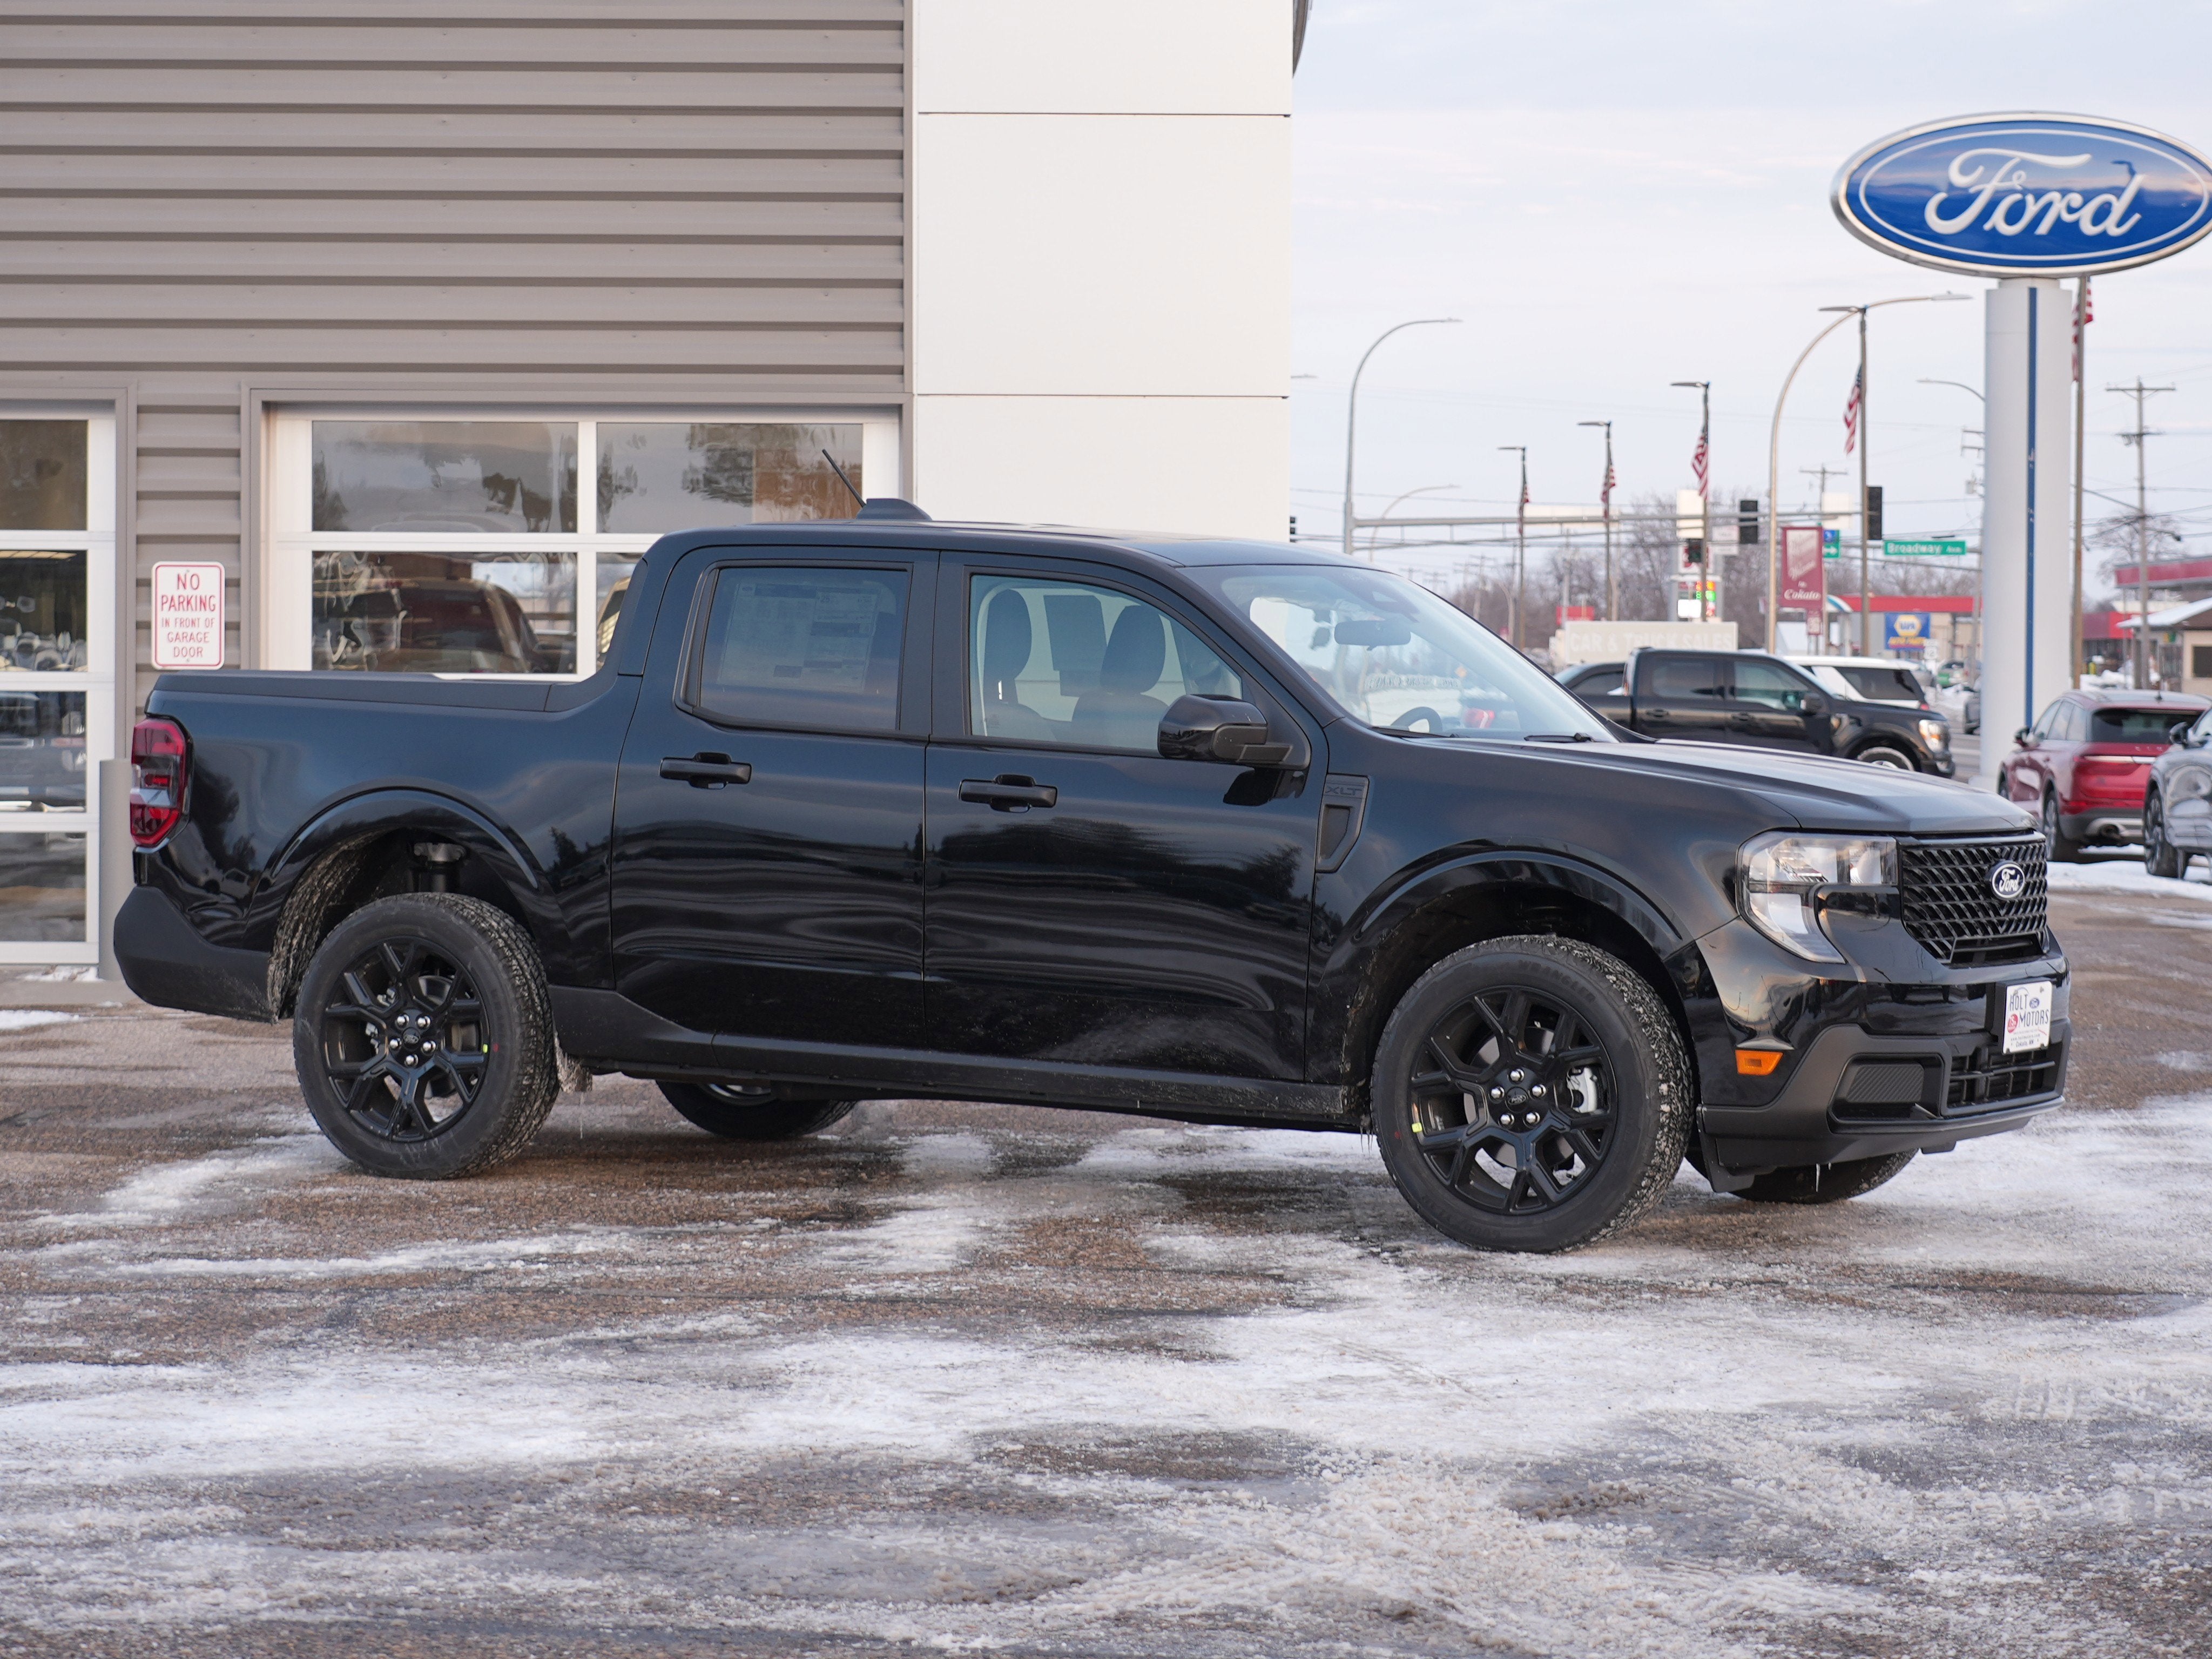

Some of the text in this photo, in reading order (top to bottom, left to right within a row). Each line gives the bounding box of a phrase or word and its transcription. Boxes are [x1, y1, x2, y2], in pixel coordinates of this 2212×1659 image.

[1924, 147, 2147, 237] Ford
[1887, 543, 1942, 555] Broadway
[177, 573, 199, 590] NO
[1784, 588, 1821, 601] Cokato
[161, 595, 216, 612] PARKING
[162, 617, 215, 628] IN FRONT OF
[167, 632, 210, 643] GARAGE
[1570, 632, 1603, 652] CAR
[173, 647, 203, 657] DOOR
[1325, 786, 1363, 796] XLT
[1999, 868, 2020, 892] Ford
[2009, 994, 2028, 1011] HOLT
[2019, 1009, 2049, 1028] MOTORS
